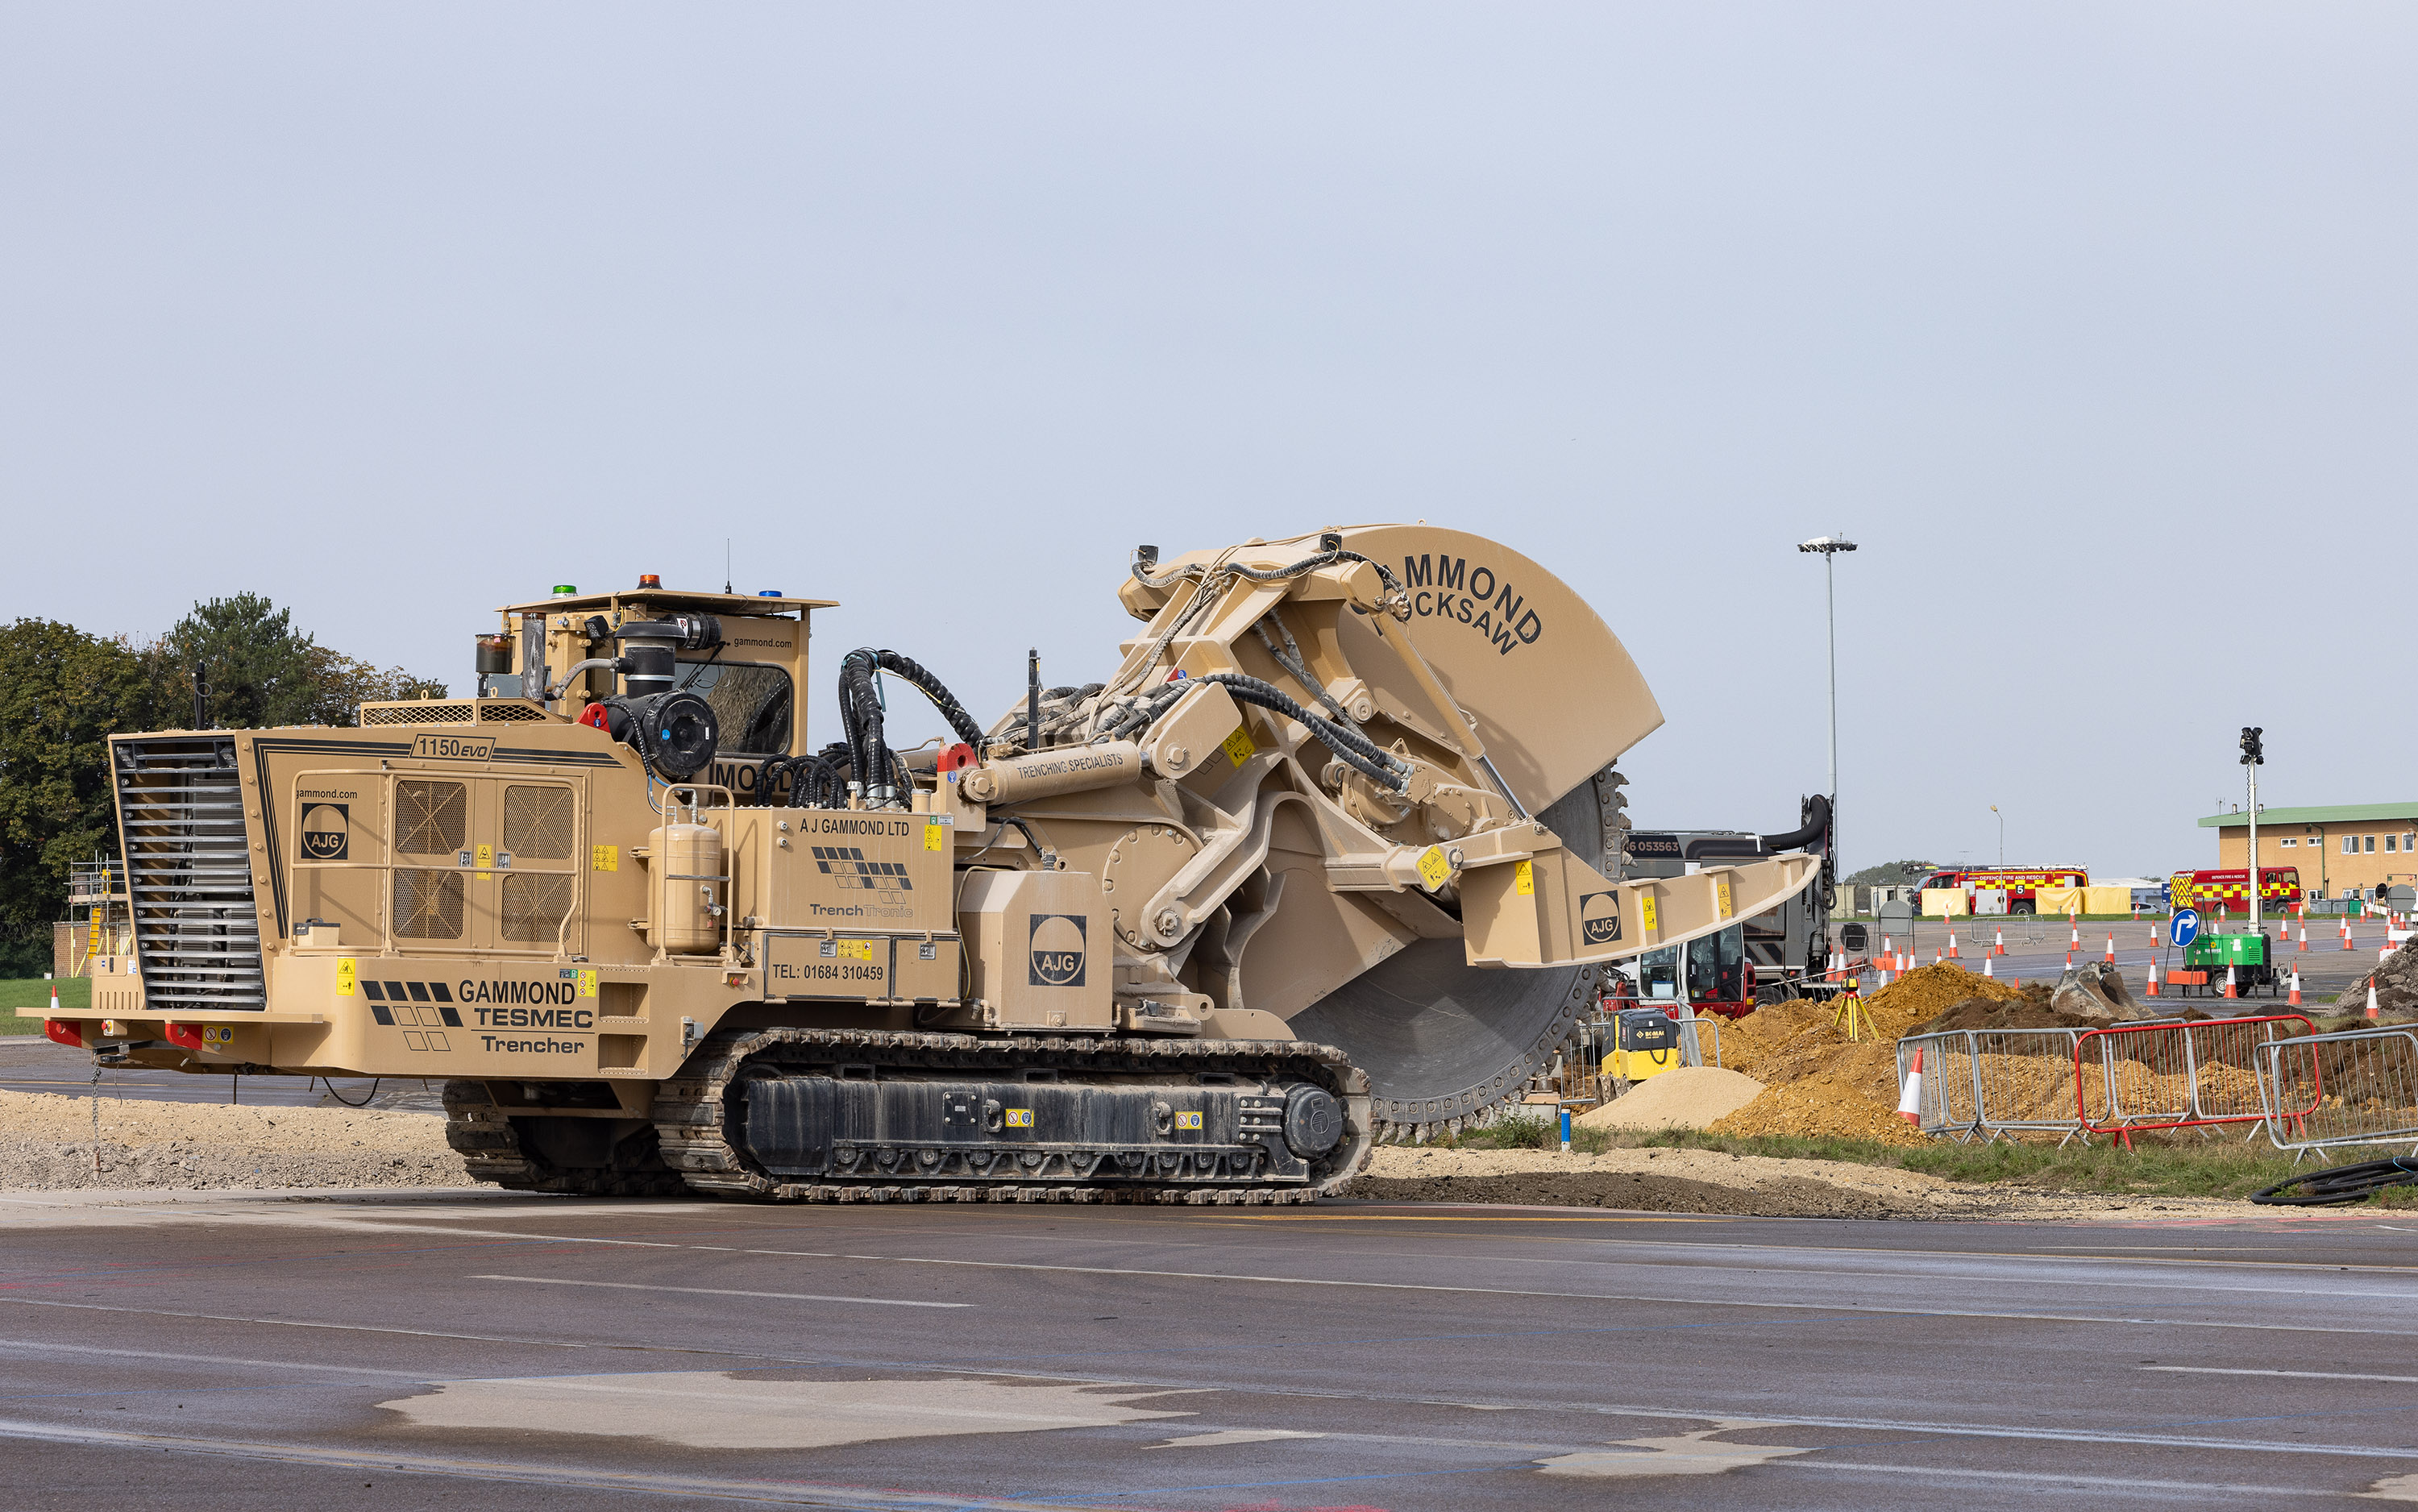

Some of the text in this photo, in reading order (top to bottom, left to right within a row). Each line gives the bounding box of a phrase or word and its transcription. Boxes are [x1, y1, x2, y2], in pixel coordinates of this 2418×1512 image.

[734, 638, 792, 648] gammond.com
[1016, 753, 1124, 779] TRENCHING SPECIALISTS
[800, 818, 909, 837] A J GAMMOND LTD
[311, 834, 339, 848] AJG
[1638, 841, 1680, 852] 053563
[810, 903, 914, 918] TrenchTronic
[1591, 919, 1614, 934] AJG
[1041, 954, 1074, 972] AJG
[773, 964, 883, 981] TEL: 01684 310459
[459, 979, 575, 1005] GAMMOND
[474, 1007, 593, 1028] TESMEC
[481, 1036, 584, 1054] Trencher
